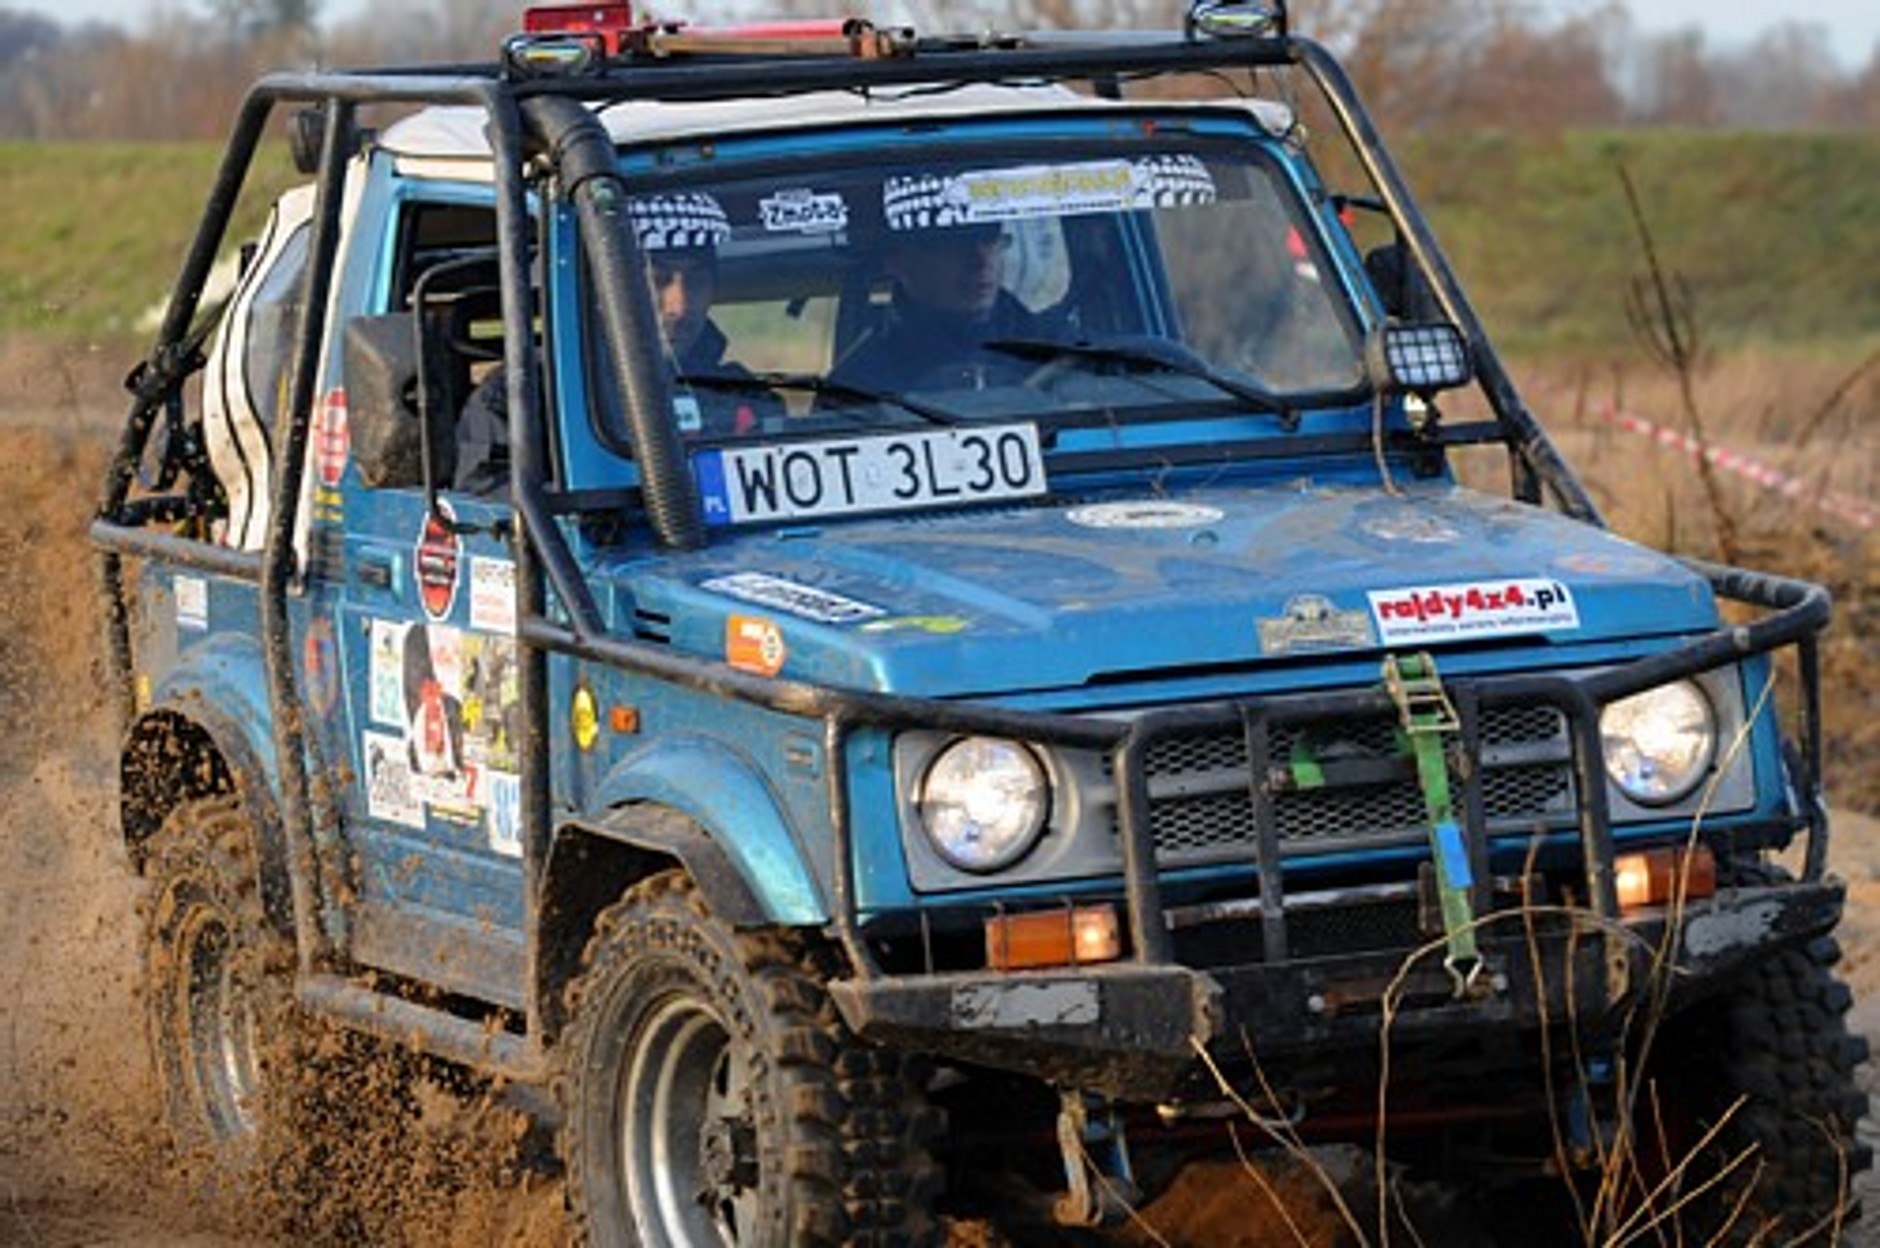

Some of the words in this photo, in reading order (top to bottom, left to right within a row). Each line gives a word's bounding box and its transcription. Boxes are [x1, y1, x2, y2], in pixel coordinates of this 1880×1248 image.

[736, 447, 858, 513] WOT
[887, 432, 1031, 498] 3L30
[1378, 583, 1567, 622] rajdy4x4.pl
